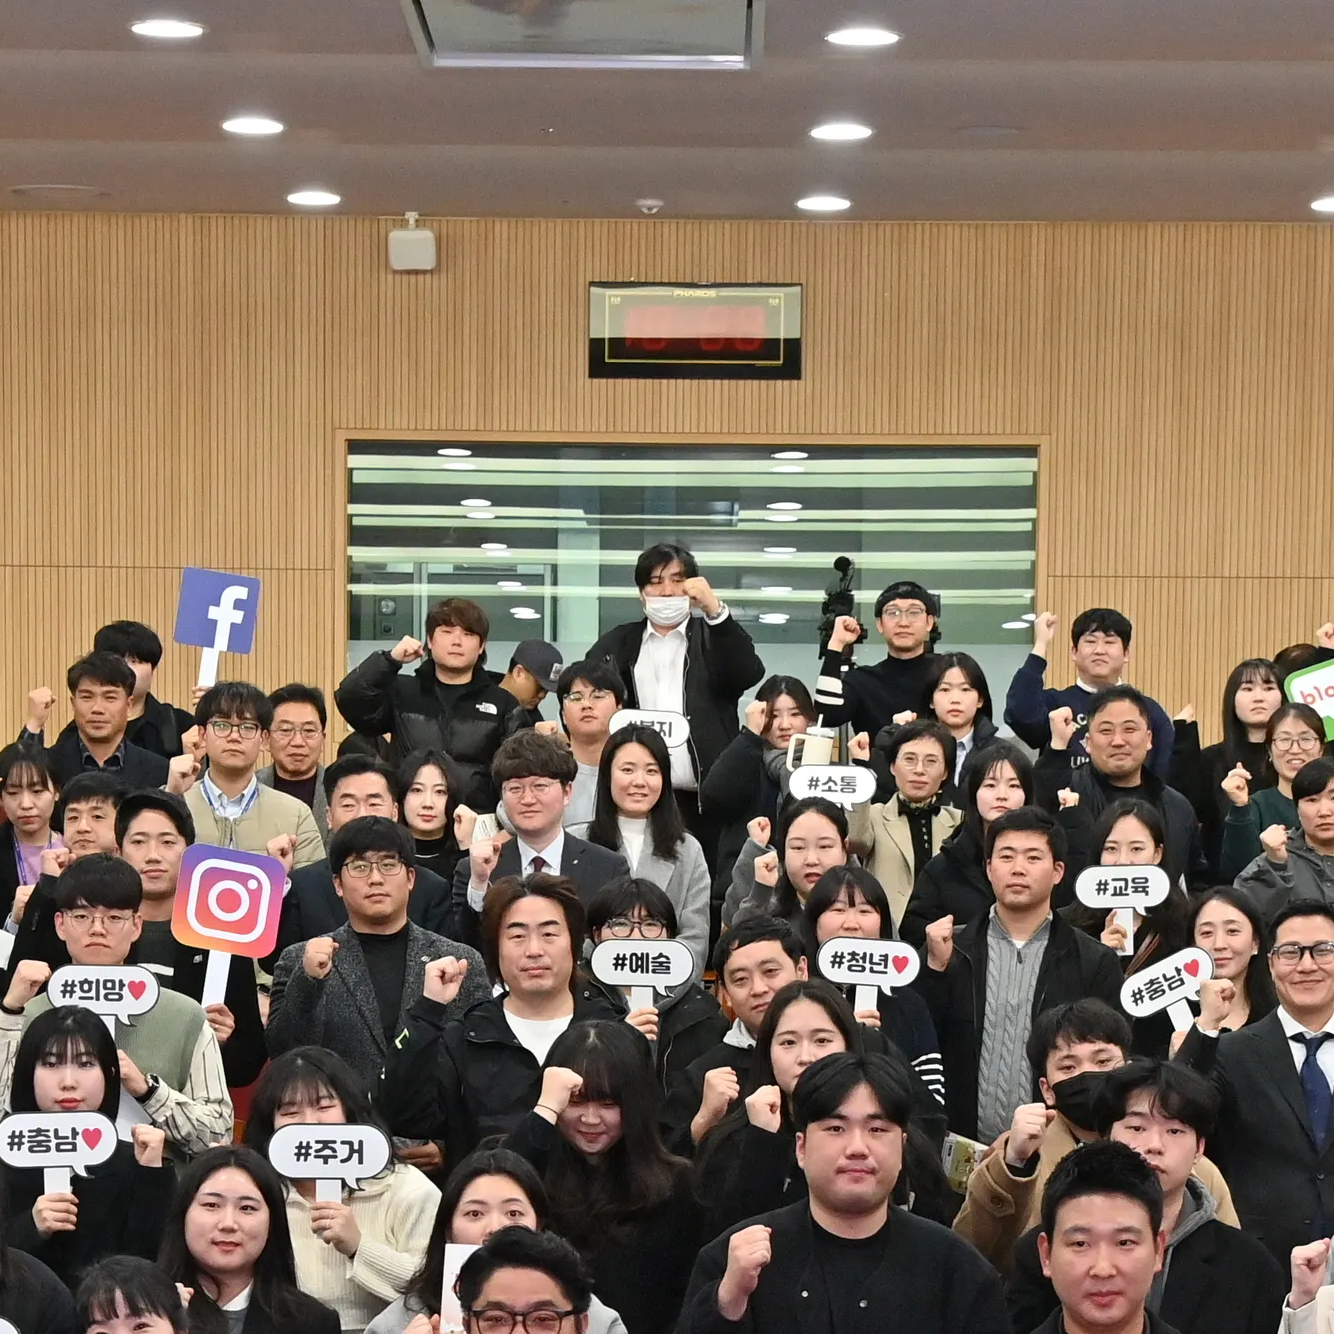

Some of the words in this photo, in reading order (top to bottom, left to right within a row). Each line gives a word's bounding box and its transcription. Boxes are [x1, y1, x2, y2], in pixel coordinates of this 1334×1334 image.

[807, 774, 857, 796] #소통
[1095, 876, 1150, 897] #교육
[612, 952, 672, 975] #예술
[829, 951, 890, 976] #청년
[59, 978, 127, 1002] #희망
[1130, 966, 1185, 1006] #충남
[6, 1127, 79, 1154] #충남
[294, 1140, 364, 1166] #주거
